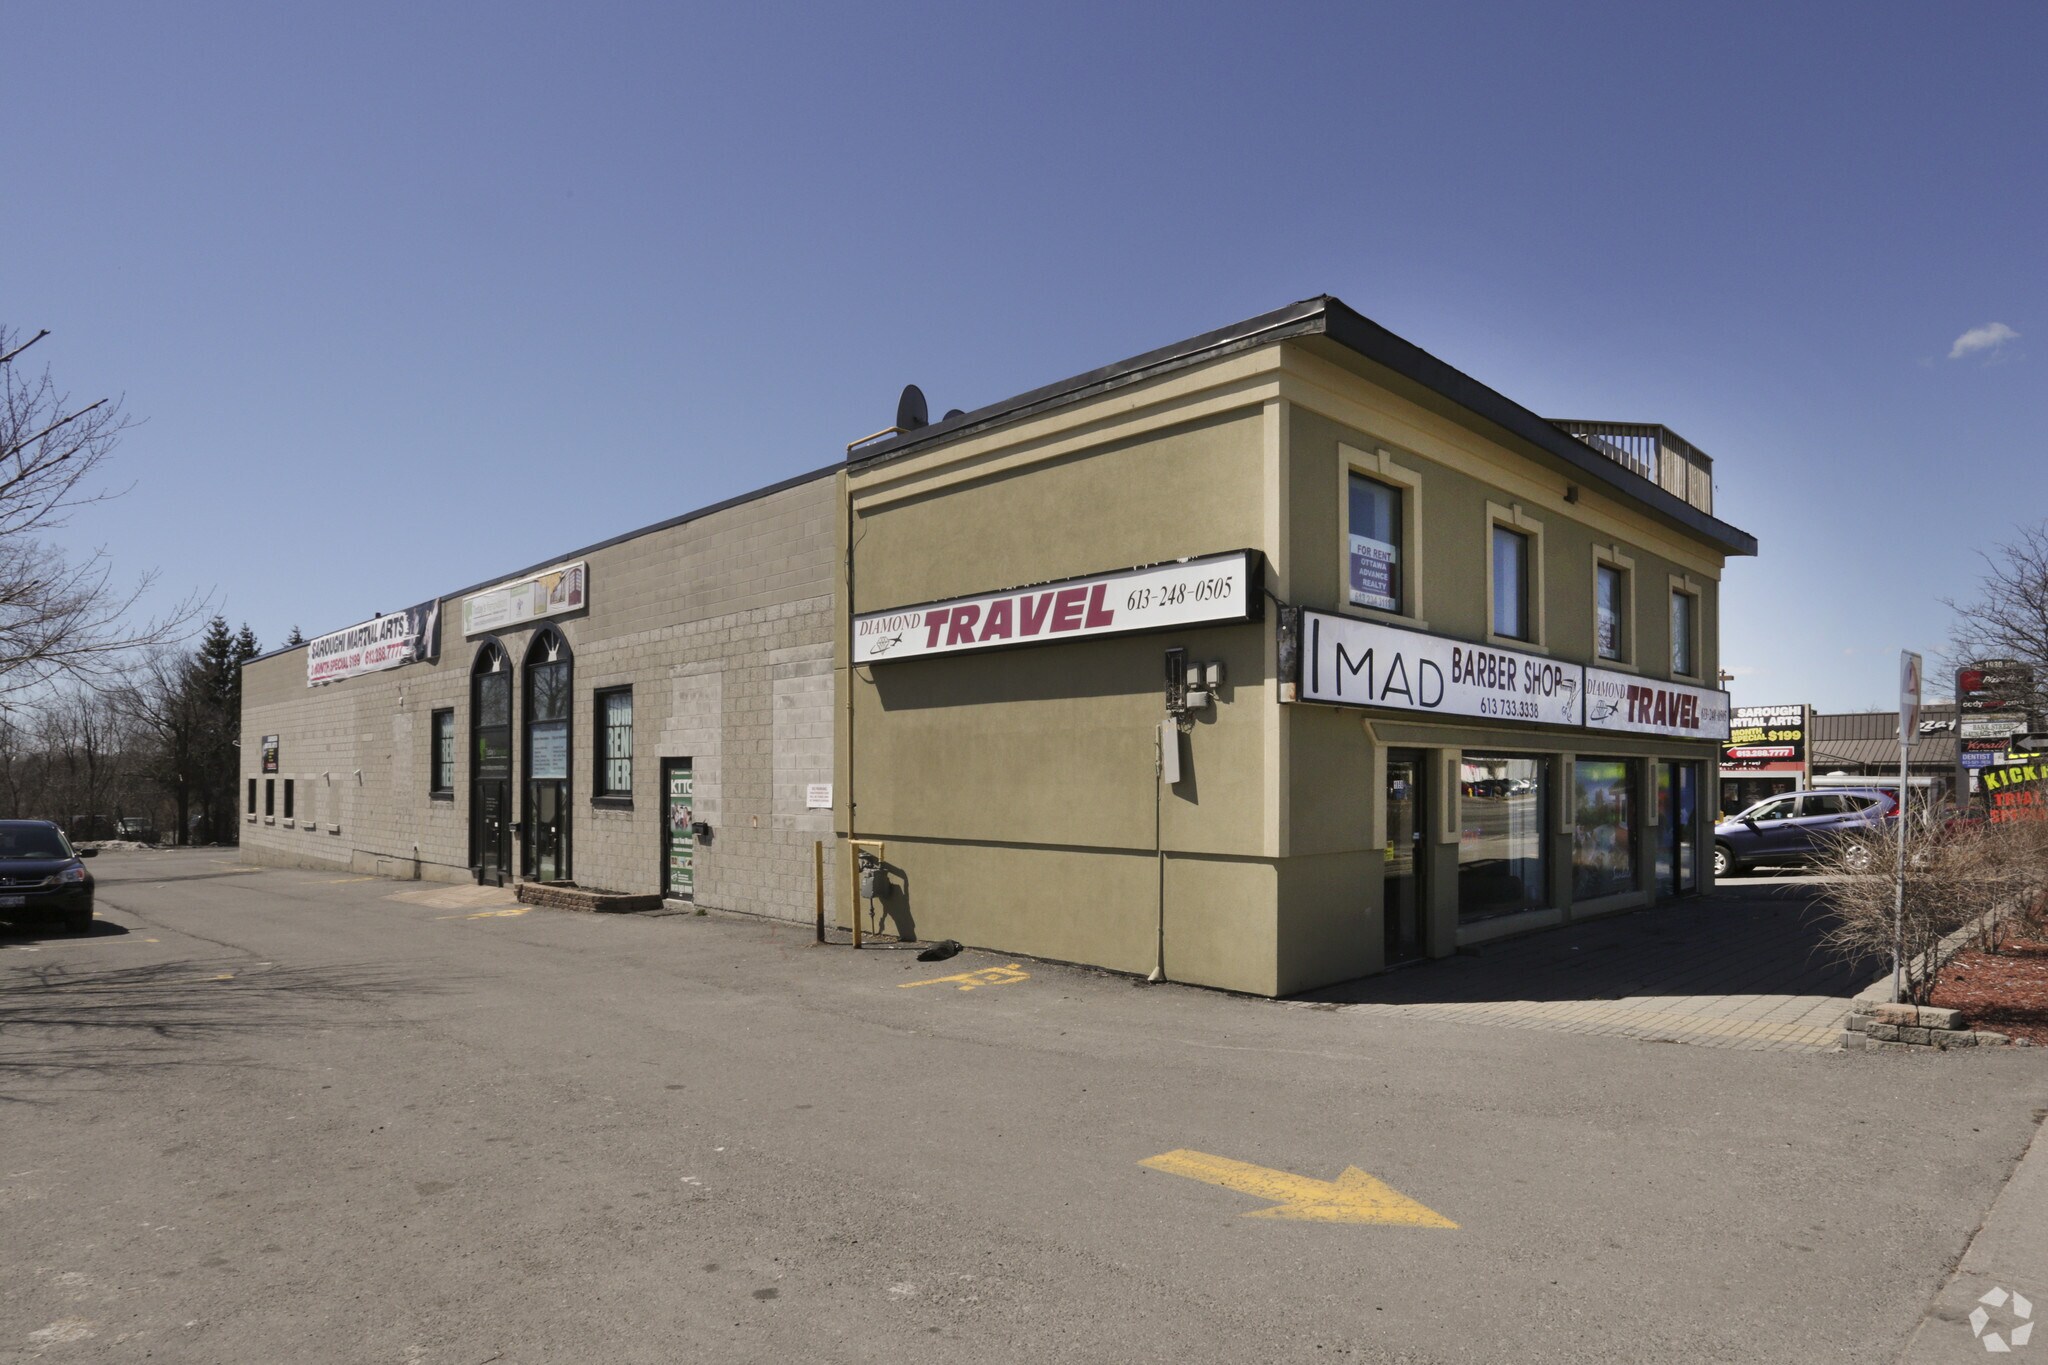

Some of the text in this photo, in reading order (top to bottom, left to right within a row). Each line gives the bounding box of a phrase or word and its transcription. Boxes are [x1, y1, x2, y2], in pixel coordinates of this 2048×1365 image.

[1357, 544, 1391, 561] FOR RENT
[1361, 559, 1387, 570] OTTAWA
[1359, 568, 1388, 580] ADVANCE
[1362, 579, 1387, 590] REALTY
[859, 576, 1233, 649] DIAMOND TRAVEL 613-248-0505
[311, 615, 404, 659] SAROUGHI MARTIAL ARTS
[1452, 646, 1562, 698] BARBER SHOP
[1480, 697, 1497, 714] 613
[1586, 678, 1625, 699] DIAMOND
[1626, 684, 1699, 730] TRAVEL
[1737, 705, 1802, 718] SAROUGHI
[1768, 716, 1802, 727] ARTS
[1731, 727, 1763, 737] MONTH
[1731, 733, 1767, 743] SPECIAL
[1768, 730, 1802, 742] $199
